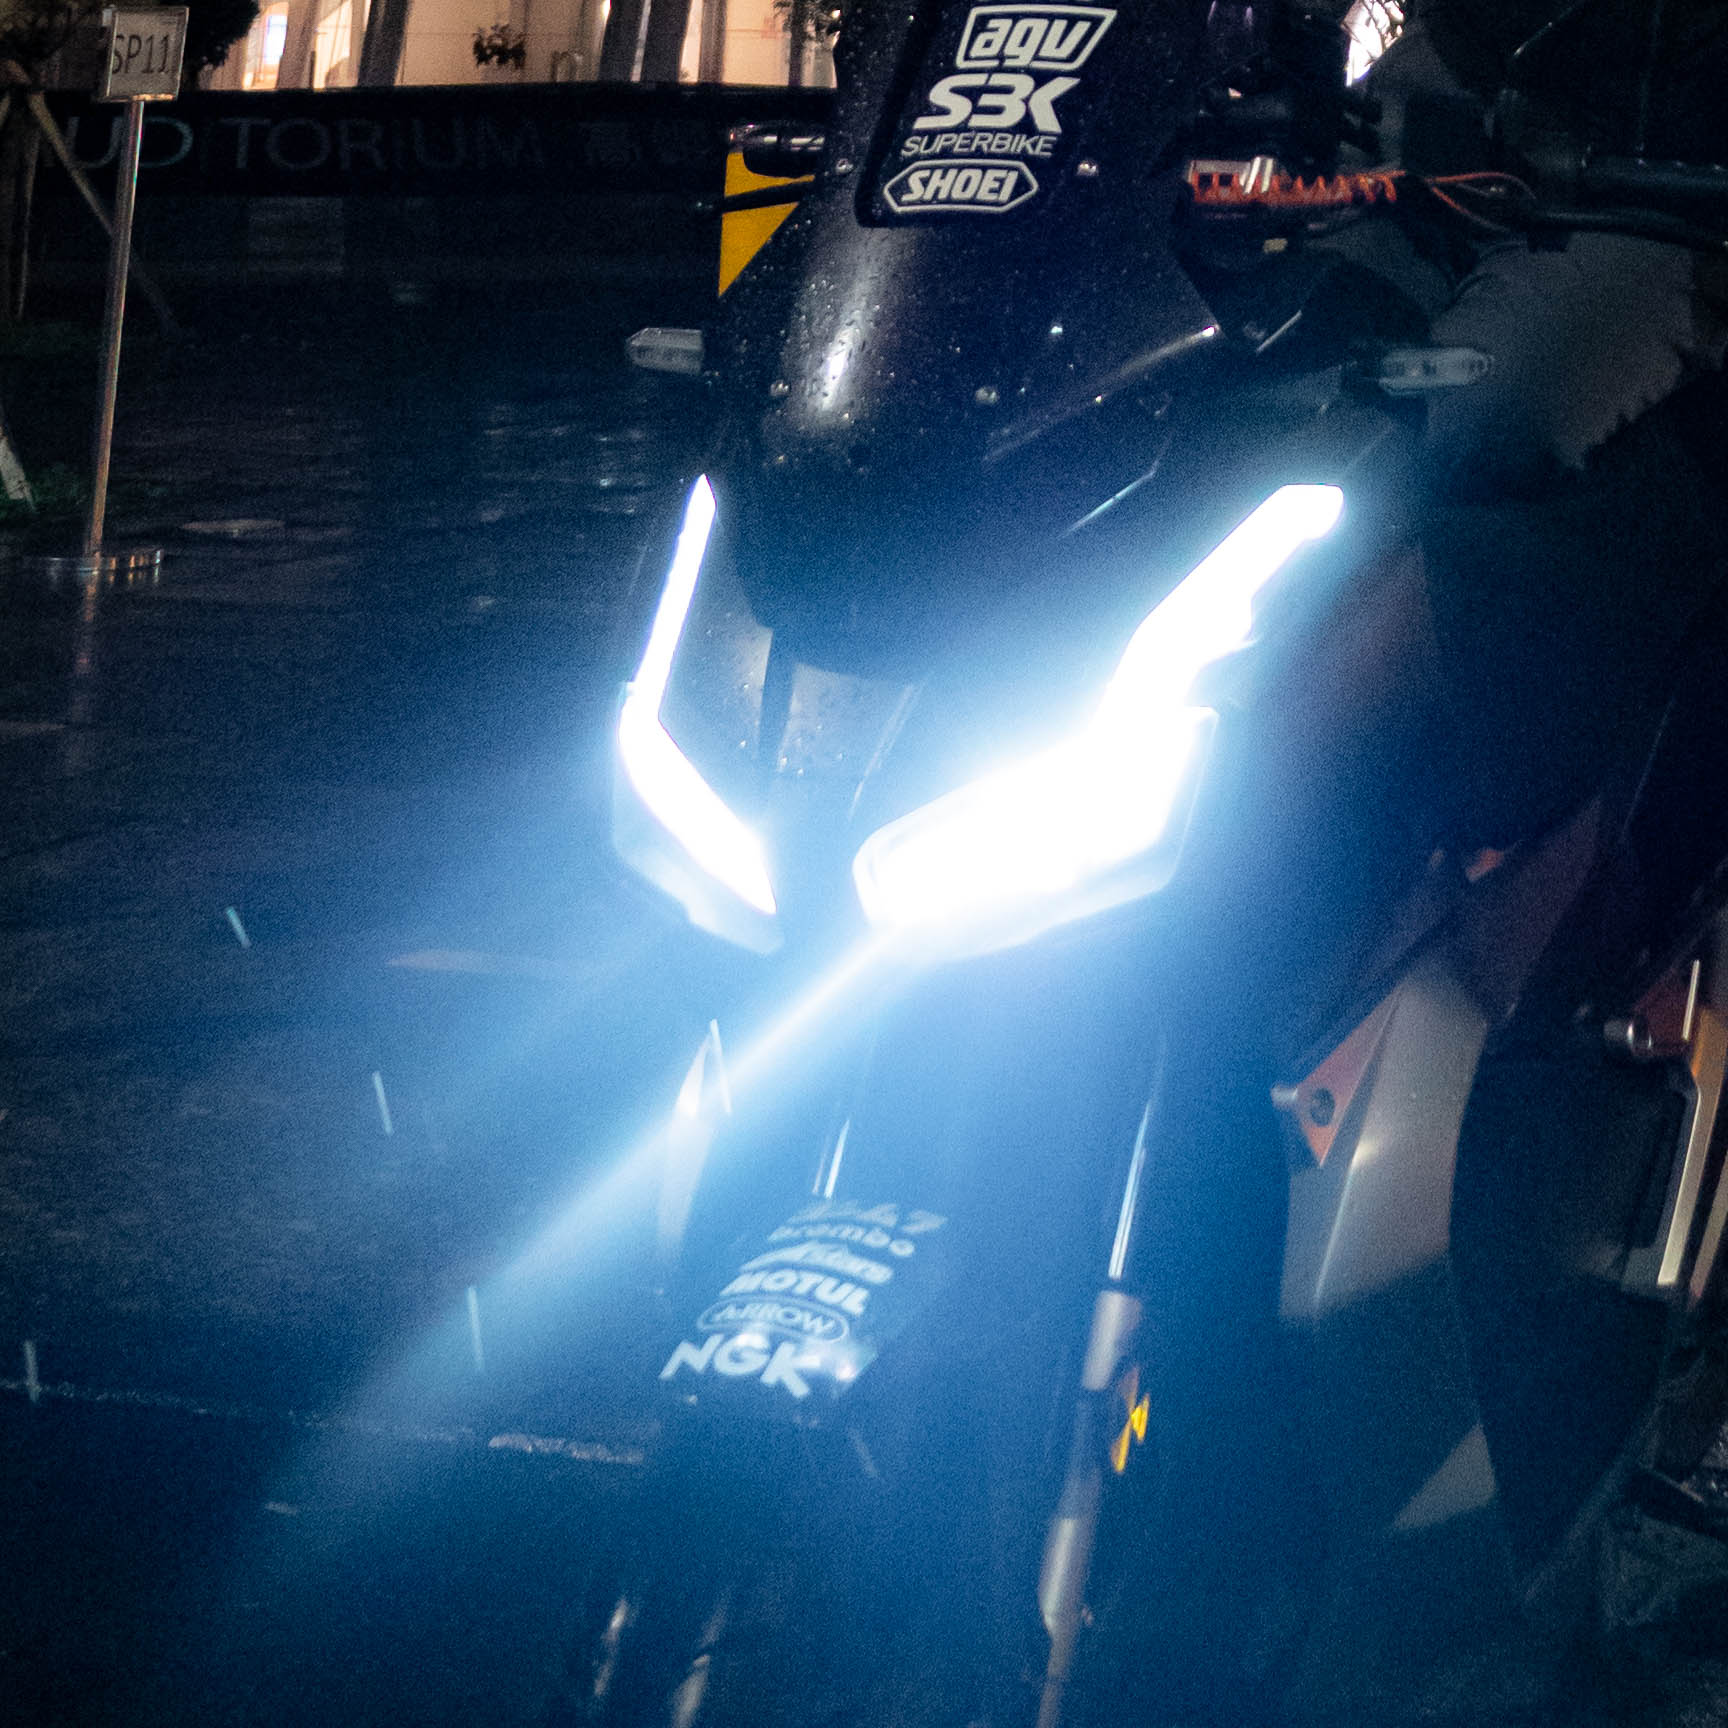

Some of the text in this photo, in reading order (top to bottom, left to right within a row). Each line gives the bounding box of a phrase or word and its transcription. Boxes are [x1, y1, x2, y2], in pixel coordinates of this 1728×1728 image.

[969, 18, 1091, 65] agv
[912, 73, 1081, 134] SBK
[901, 132, 1057, 157] SUPERBIKE
[901, 167, 1019, 203] SHOEI
[719, 1269, 870, 1317] MOTUL
[658, 1333, 820, 1399] NGK
